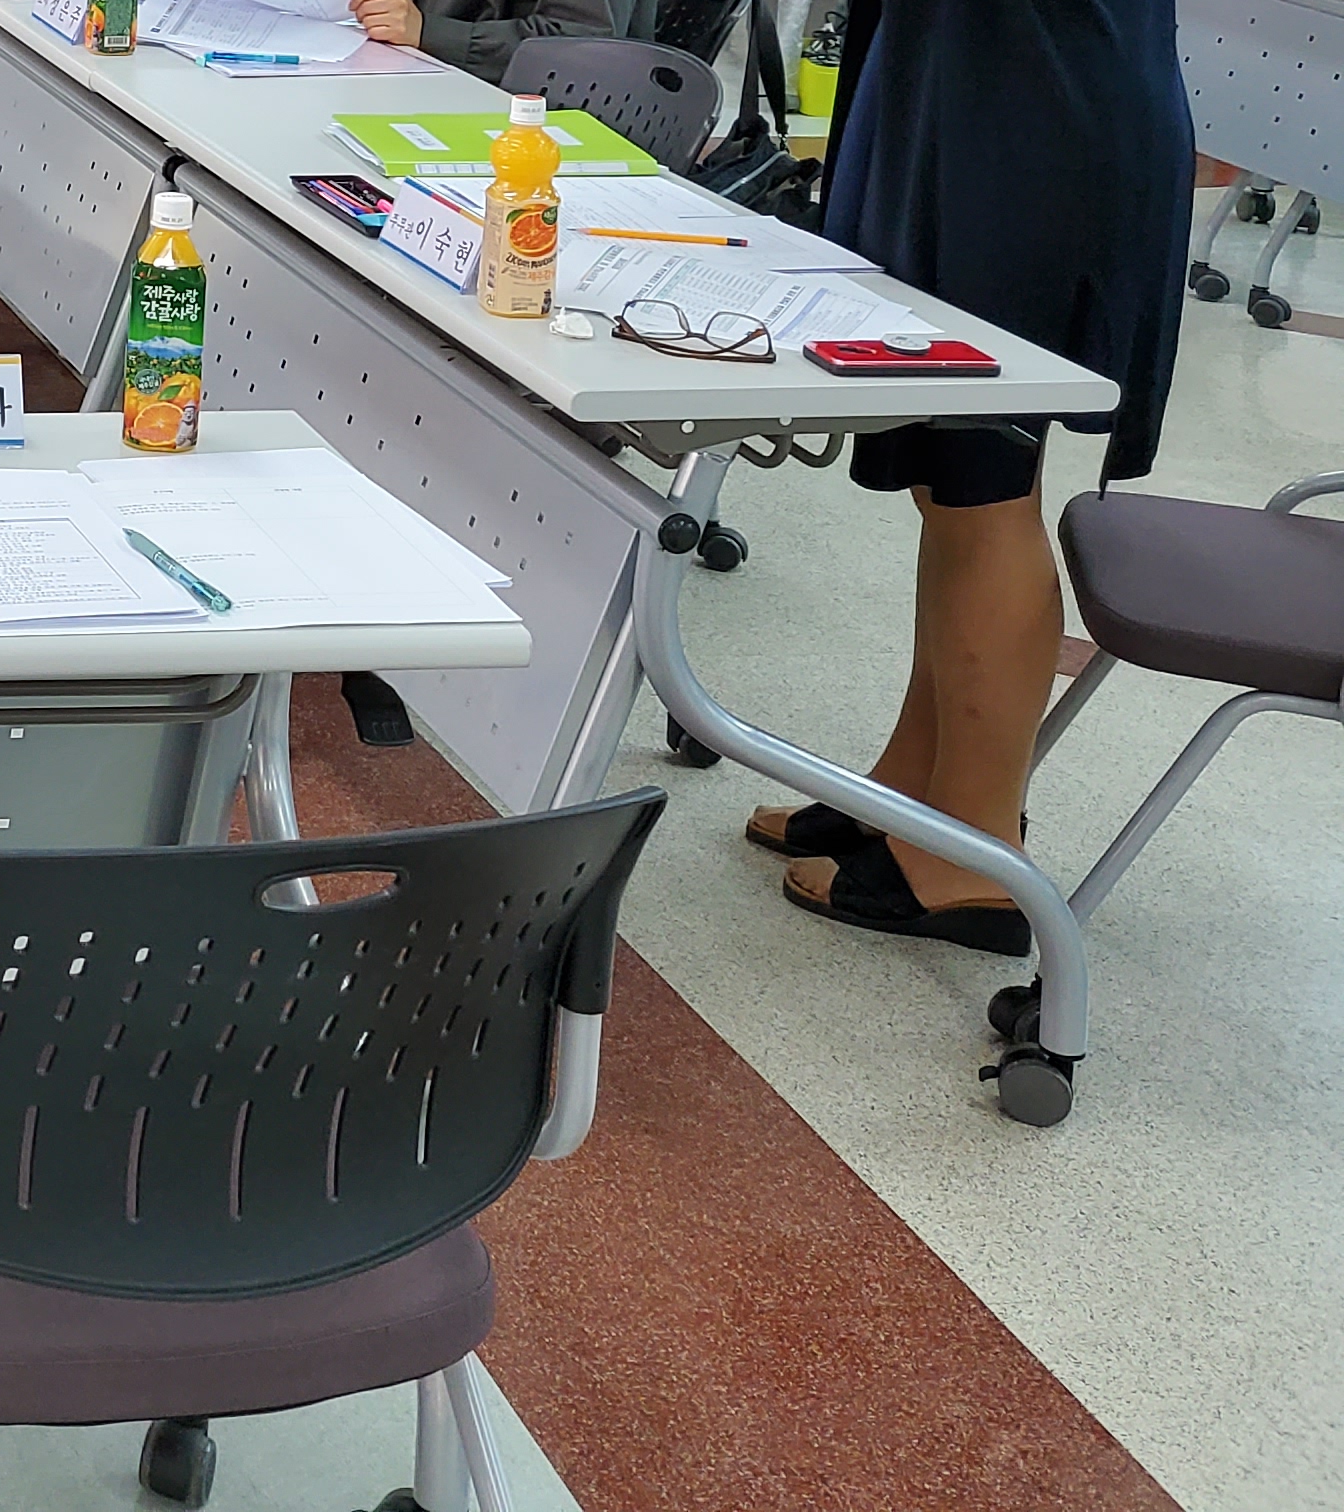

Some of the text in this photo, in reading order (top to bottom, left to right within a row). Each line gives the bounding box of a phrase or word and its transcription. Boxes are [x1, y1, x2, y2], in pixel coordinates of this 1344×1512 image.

[415, 217, 474, 274] 이숙현
[143, 284, 199, 304] 제주사랑
[140, 300, 201, 323] 감귤사랑
